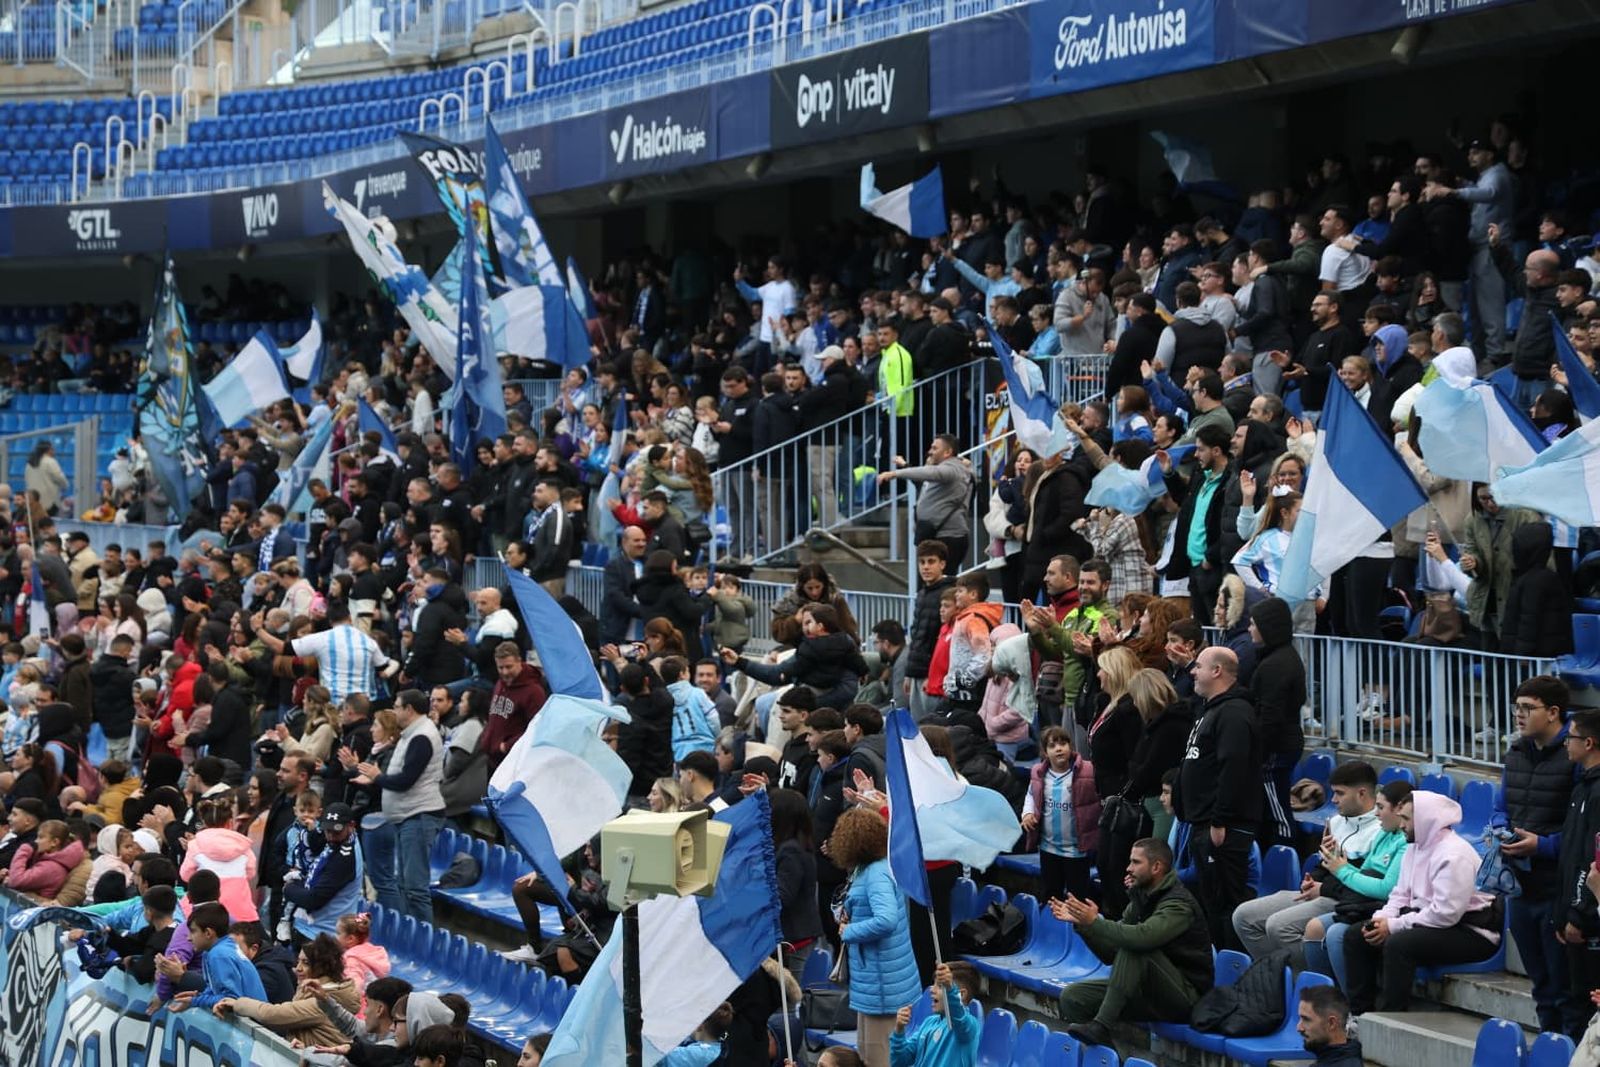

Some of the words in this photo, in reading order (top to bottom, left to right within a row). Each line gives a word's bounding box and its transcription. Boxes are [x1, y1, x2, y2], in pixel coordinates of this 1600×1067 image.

[1054, 14, 1105, 71] Ford
[1105, 0, 1187, 60] Autovisa
[844, 64, 896, 114] vitaly
[633, 115, 682, 161] Halcón
[681, 126, 706, 154] viajes
[504, 143, 541, 181] utique
[368, 171, 407, 199] trevenque
[76, 208, 117, 241] GTL
[673, 708, 696, 736] 11
